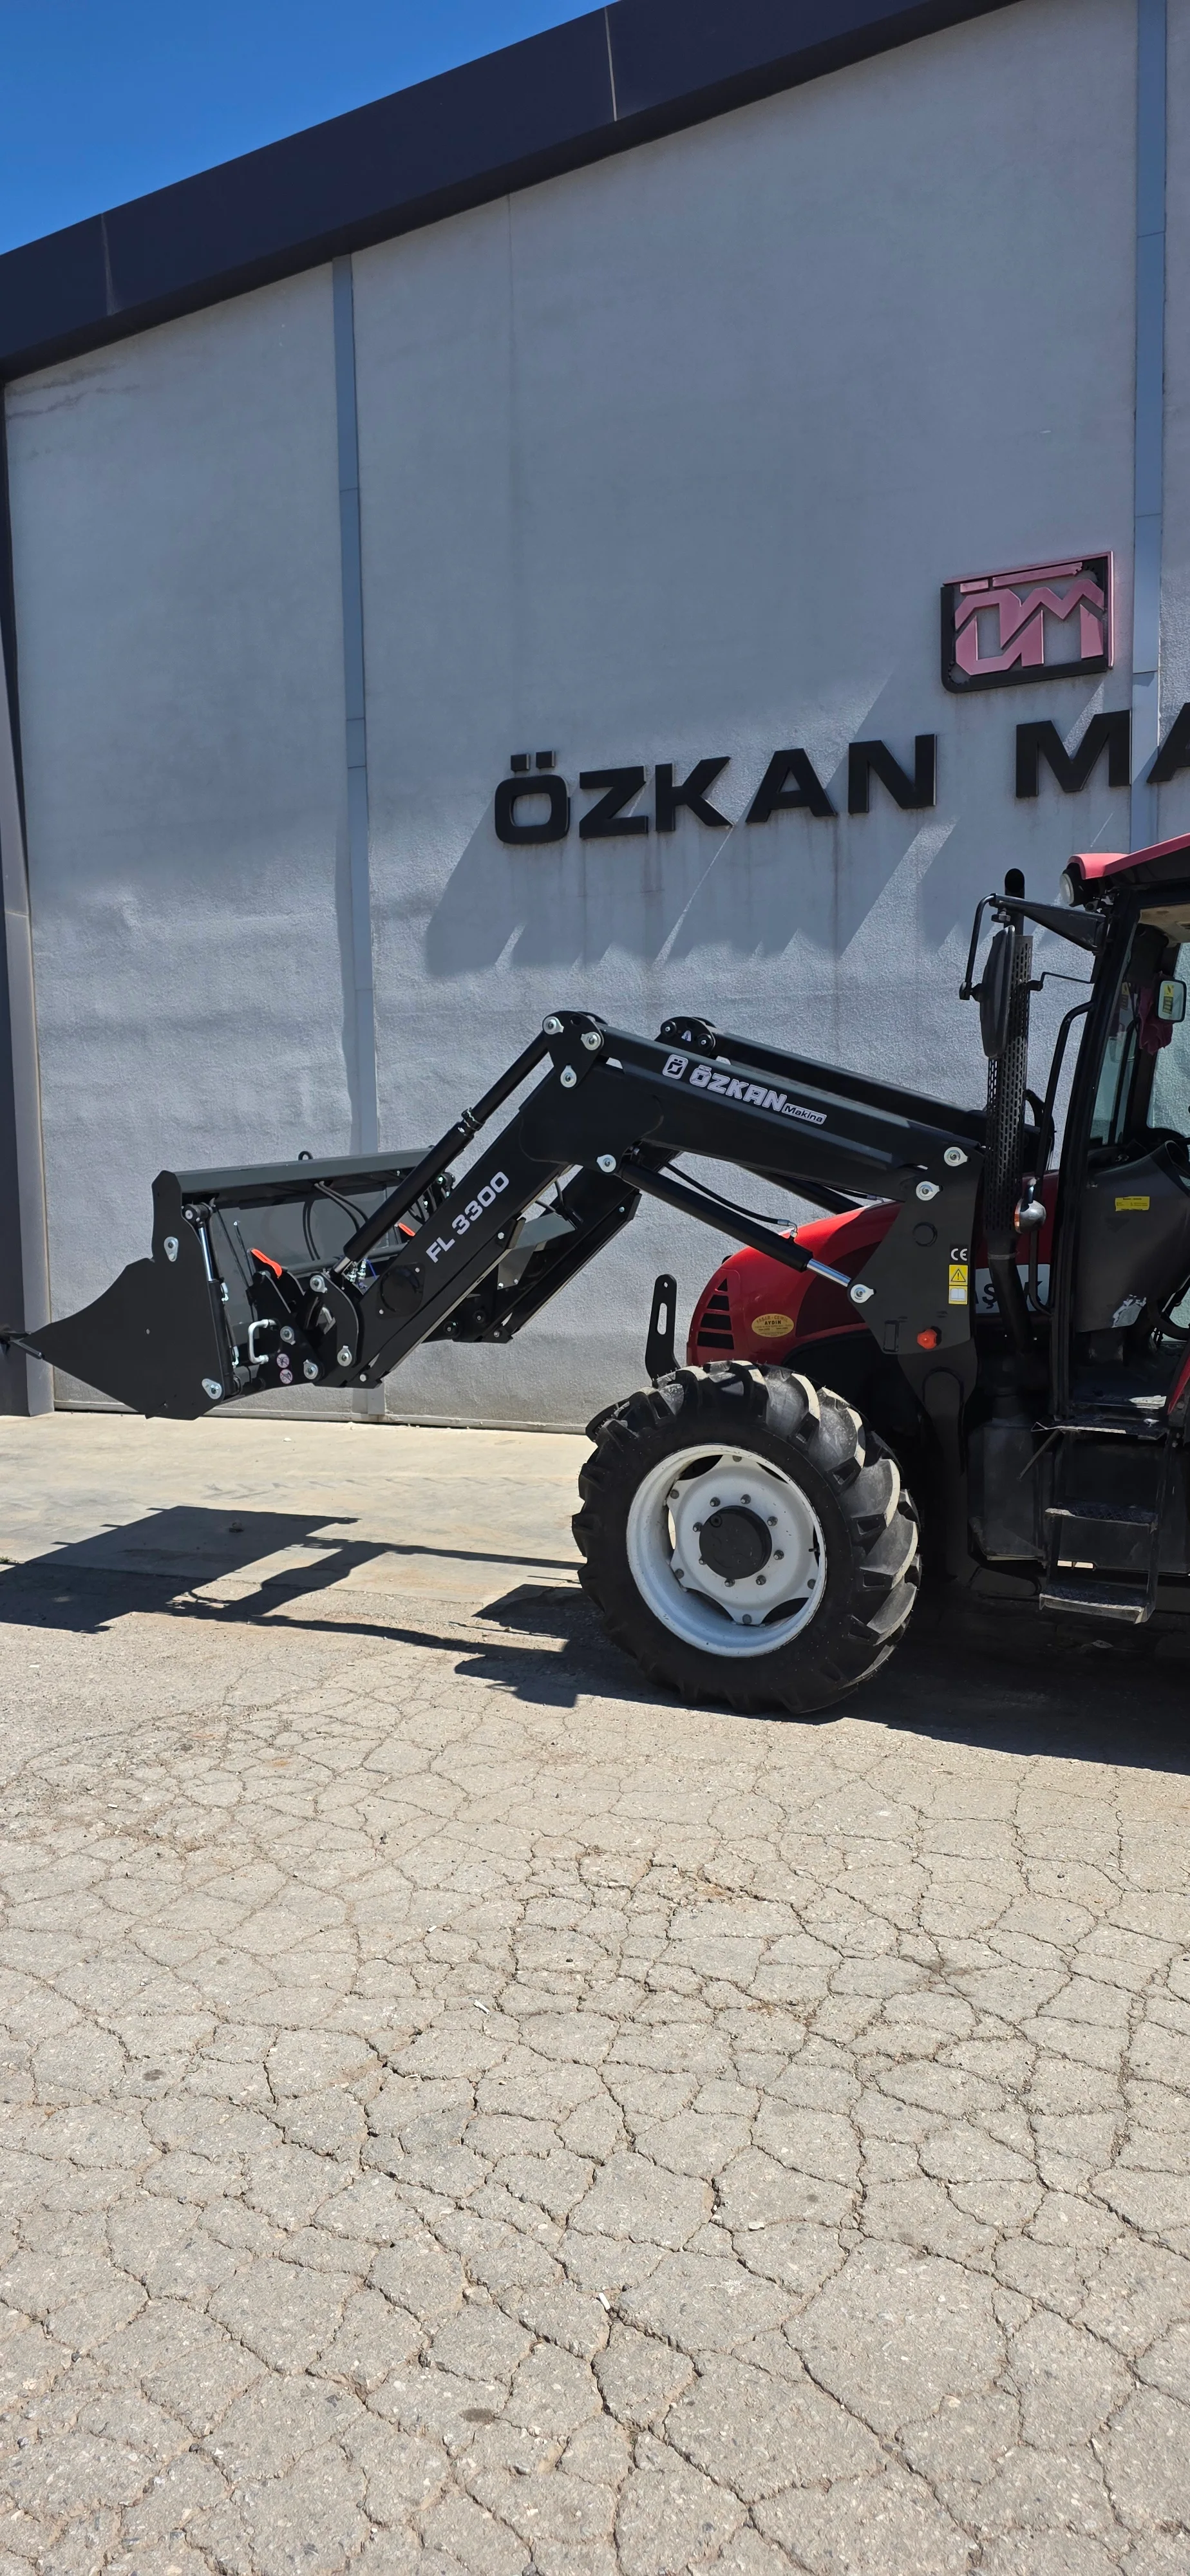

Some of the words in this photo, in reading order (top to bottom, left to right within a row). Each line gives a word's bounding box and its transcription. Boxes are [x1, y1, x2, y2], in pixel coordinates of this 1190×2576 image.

[495, 734, 937, 844] ÖZKAN
[689, 1065, 788, 1112] ÖZKAN
[784, 1104, 824, 1123] Makina
[426, 1236, 455, 1263] FL
[451, 1171, 509, 1235] 3300
[950, 1248, 968, 1261] CE
